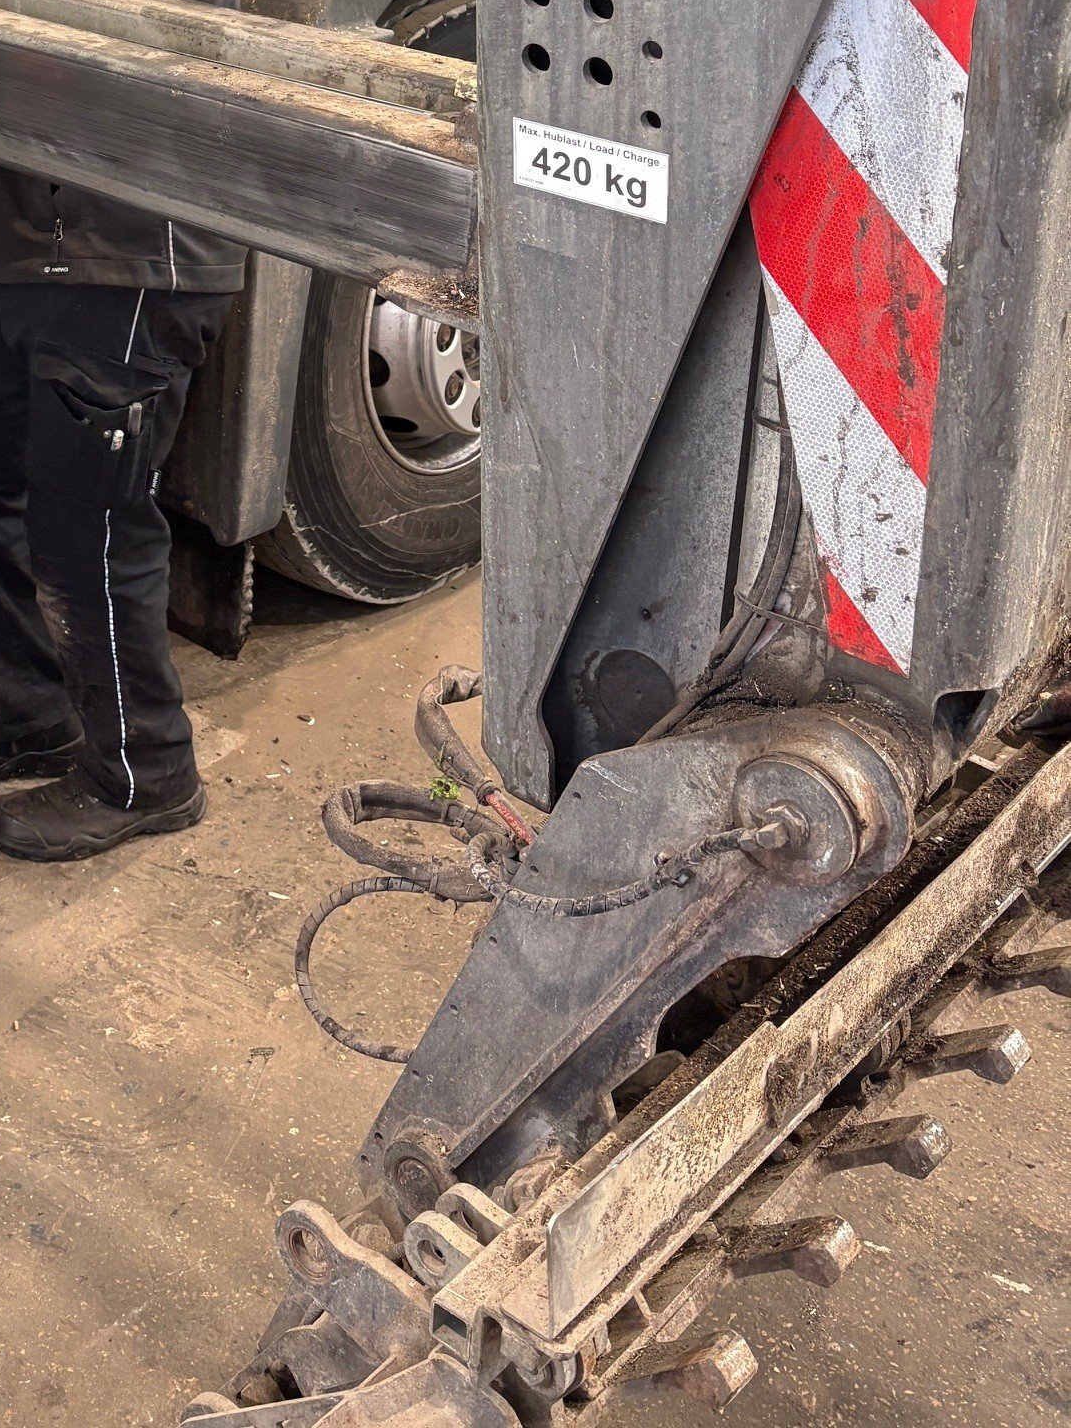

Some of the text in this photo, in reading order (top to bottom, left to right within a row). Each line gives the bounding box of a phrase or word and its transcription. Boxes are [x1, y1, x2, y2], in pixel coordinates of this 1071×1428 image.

[519, 124, 660, 167] Max. Hublast / Load / Charge
[532, 147, 647, 208] 420 kg
